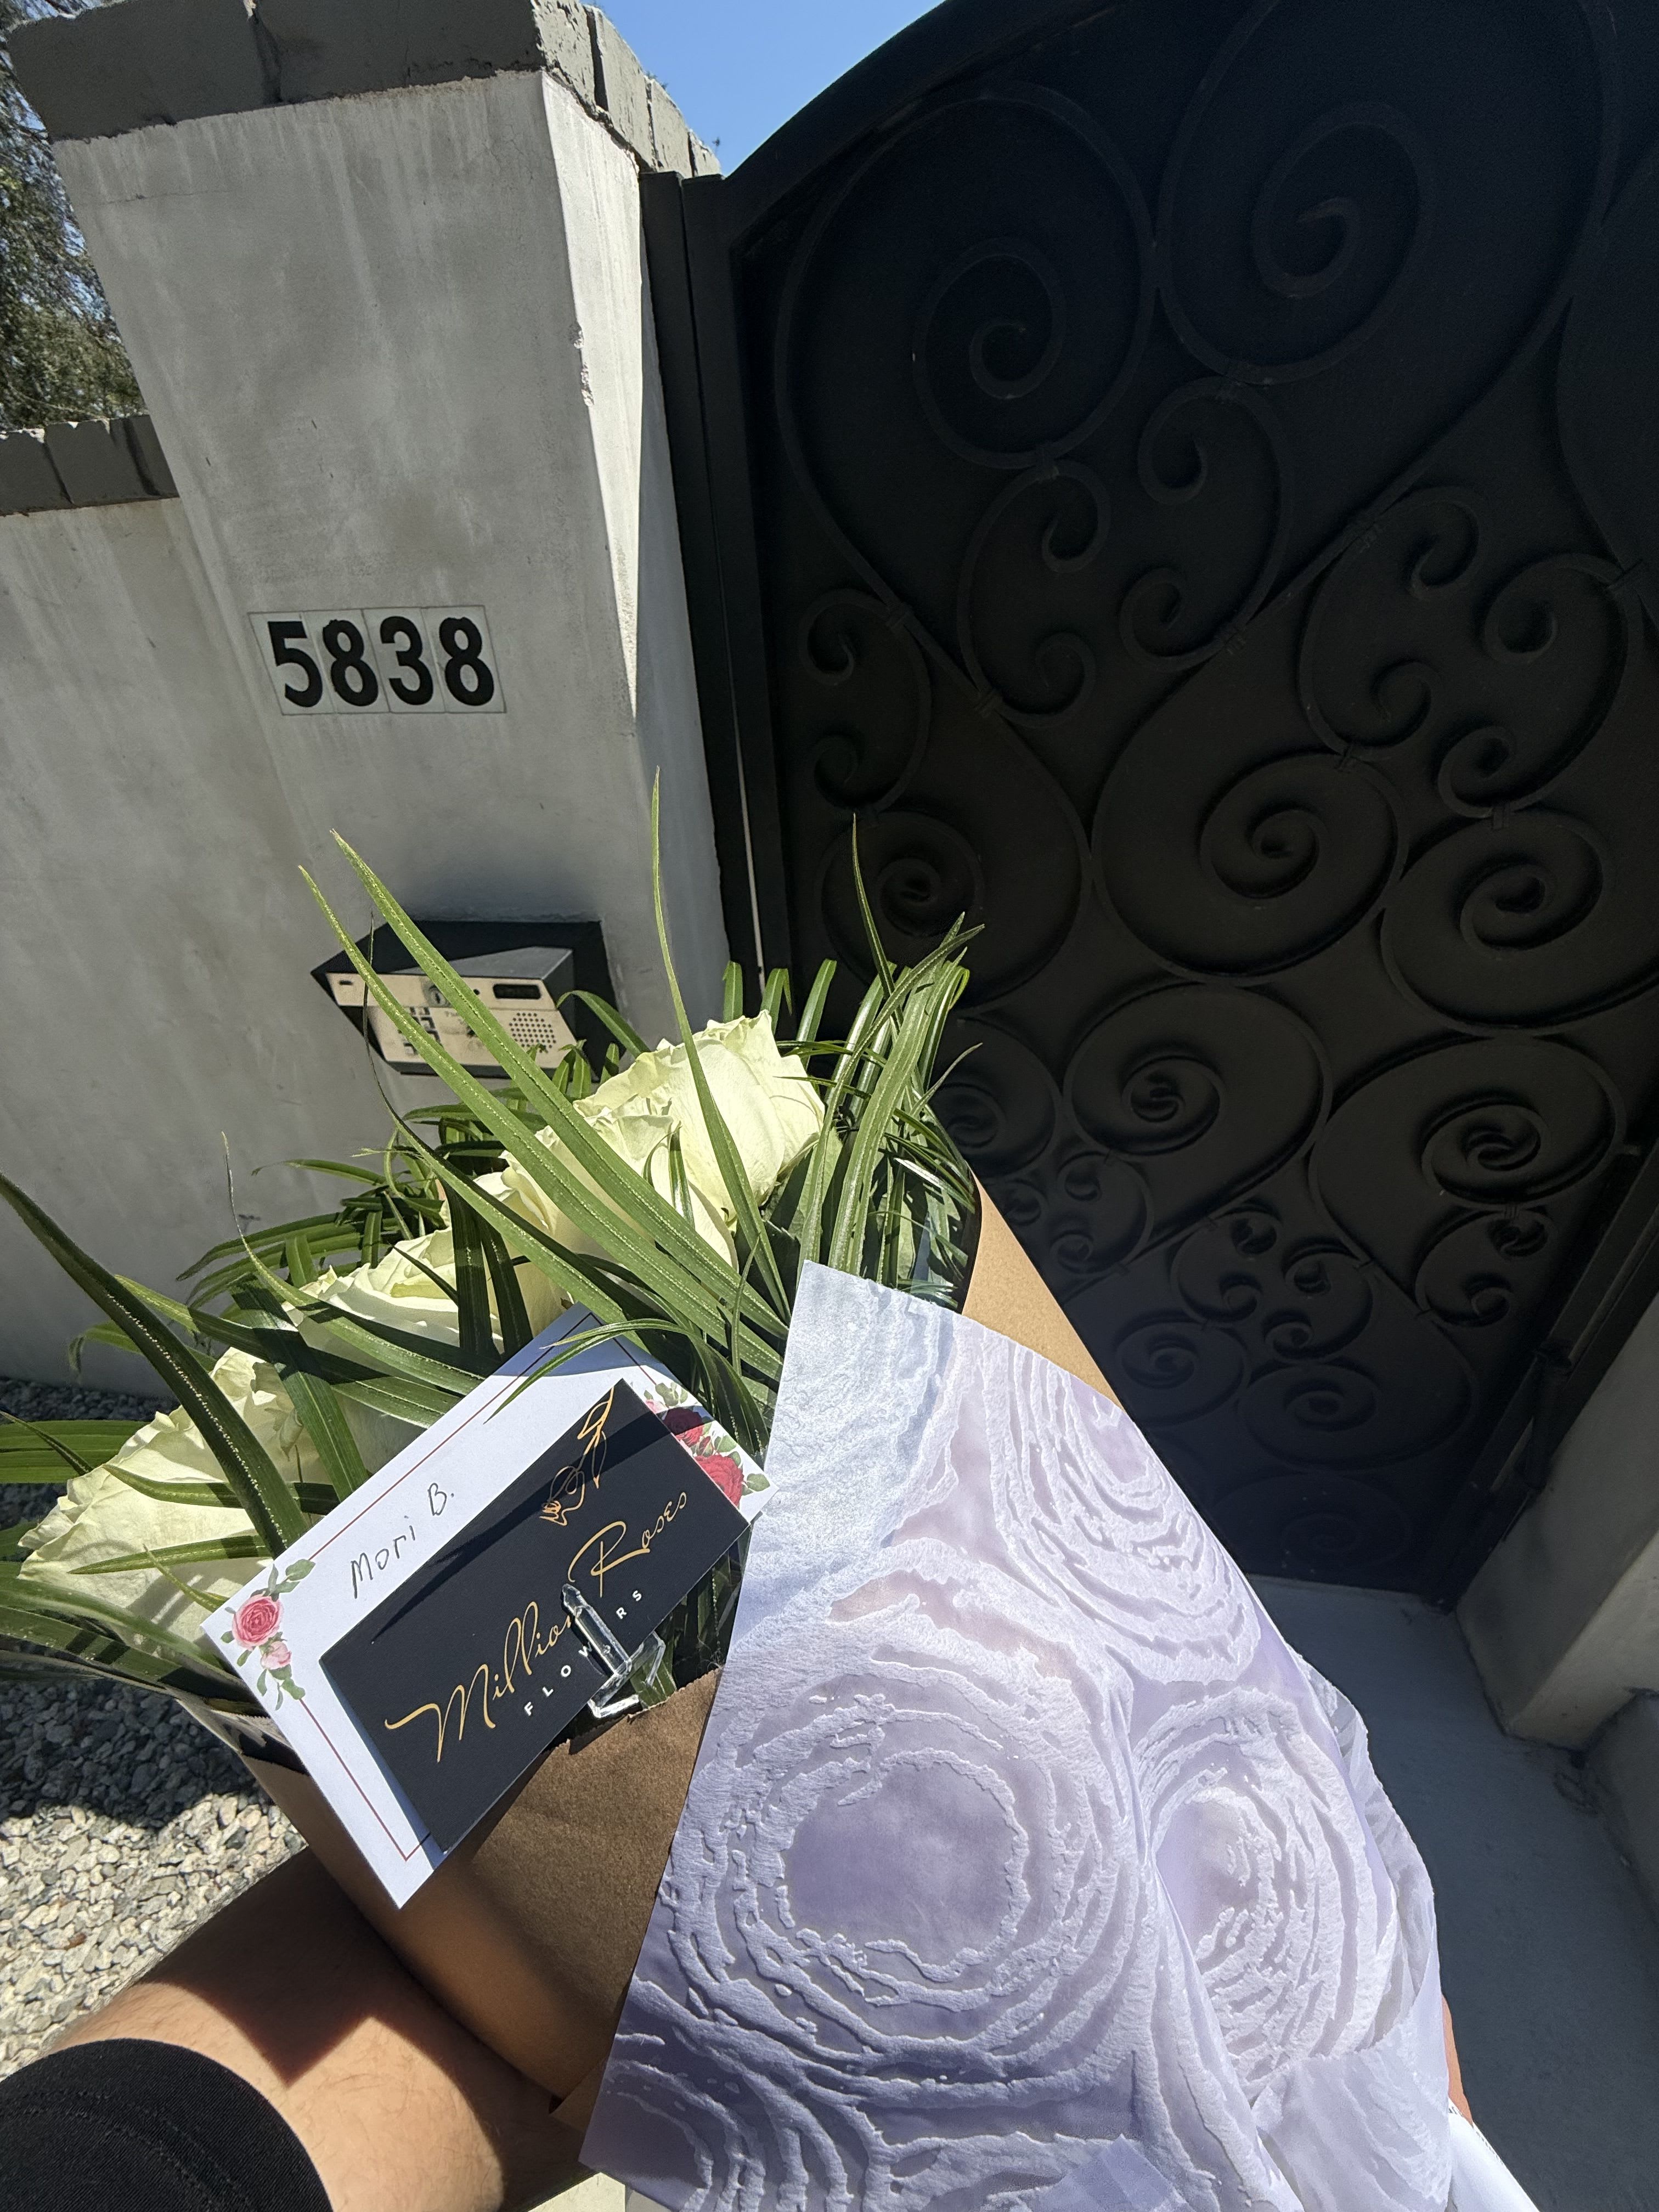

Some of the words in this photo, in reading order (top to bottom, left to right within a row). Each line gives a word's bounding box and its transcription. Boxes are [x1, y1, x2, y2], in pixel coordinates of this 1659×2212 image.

[268, 616, 494, 708] 5838
[351, 1515, 415, 1599] Mori
[427, 1482, 454, 1516] B.
[567, 1492, 687, 1598] Roses
